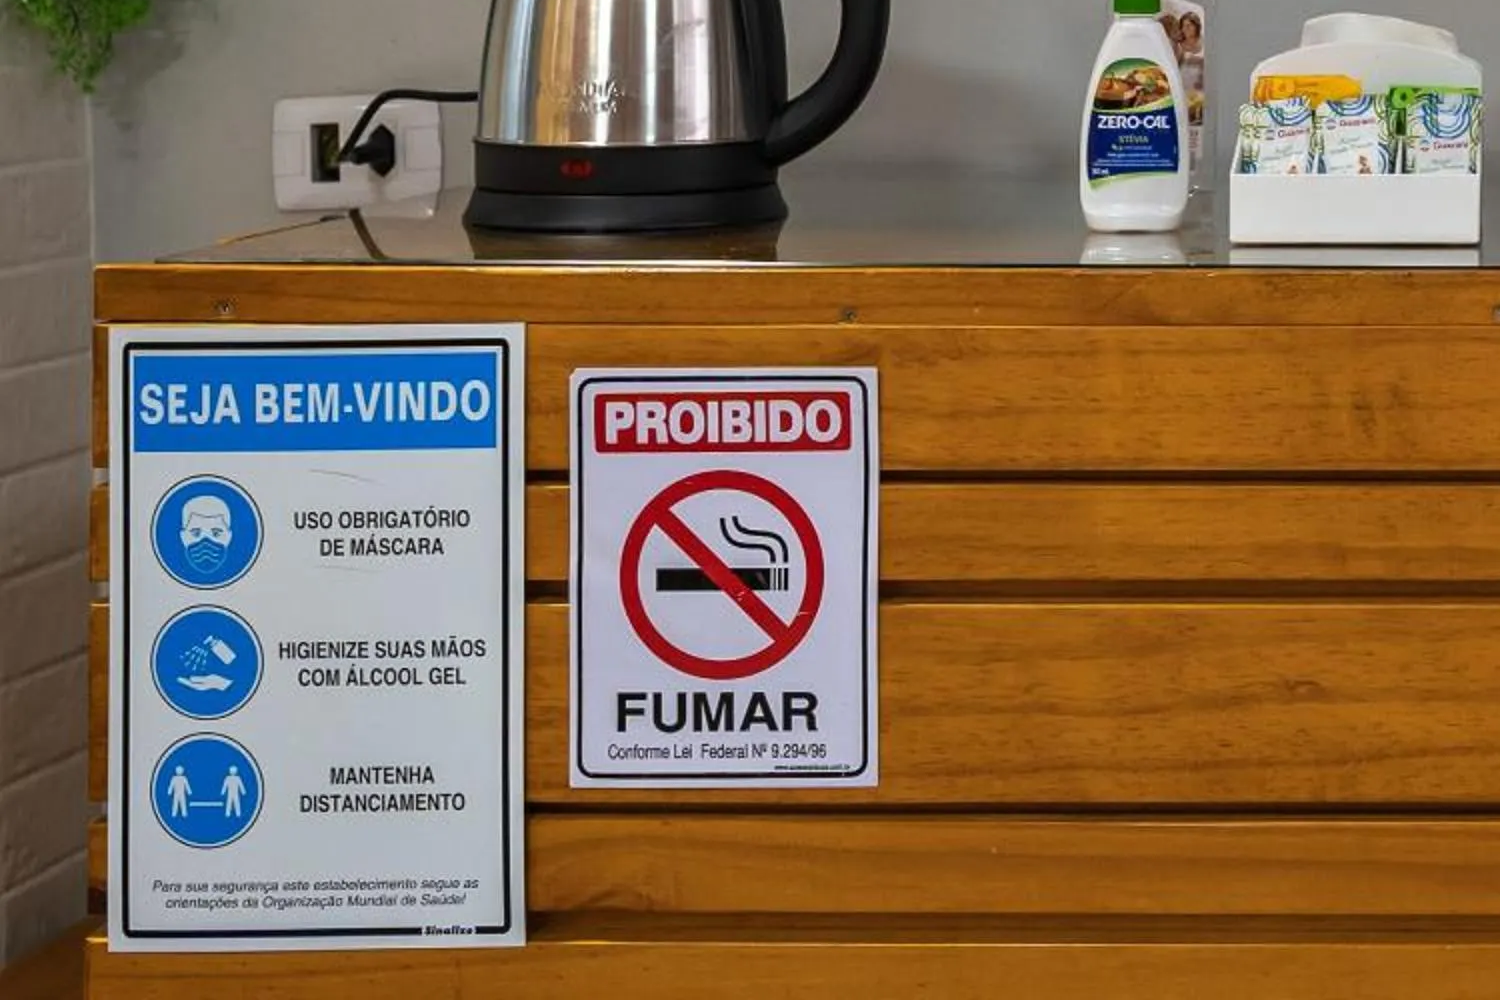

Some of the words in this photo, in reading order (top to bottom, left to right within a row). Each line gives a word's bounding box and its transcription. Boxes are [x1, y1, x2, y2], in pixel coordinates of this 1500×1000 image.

[1097, 114, 1171, 129] ZERO-CAL
[139, 383, 241, 425] SEJA
[255, 379, 490, 423] BEM-VINDO
[605, 400, 842, 445] PROIBIDO
[294, 511, 333, 530] USO
[339, 506, 471, 529] OBRIGATÓRIO
[320, 538, 344, 556] DE
[350, 533, 444, 556] MÁSCARA
[278, 641, 369, 660] HIGIENIZE
[374, 640, 425, 658] SUAS
[431, 635, 486, 657] MÃOS
[298, 668, 341, 686] COM
[346, 664, 422, 686] ÁLCOOL
[428, 666, 466, 685] GEL
[617, 692, 818, 732] FUMAR
[608, 744, 670, 760] Conforme
[673, 744, 693, 759] Lei
[701, 743, 748, 759] Federal
[771, 743, 827, 759] 9.294/96
[329, 767, 435, 785] MANTENHA
[300, 793, 465, 813] DISTANCIAMENTO
[152, 879, 182, 893] Para
[185, 882, 209, 892] sua
[211, 881, 279, 894] segurança
[282, 881, 309, 891] este
[313, 879, 416, 891] estabelecimento
[420, 879, 460, 892] segue
[463, 879, 479, 889] as
[165, 896, 238, 911] orientações
[241, 898, 259, 909] da
[261, 895, 343, 910] Organização
[346, 895, 398, 906] Mundial
[401, 894, 417, 906] de
